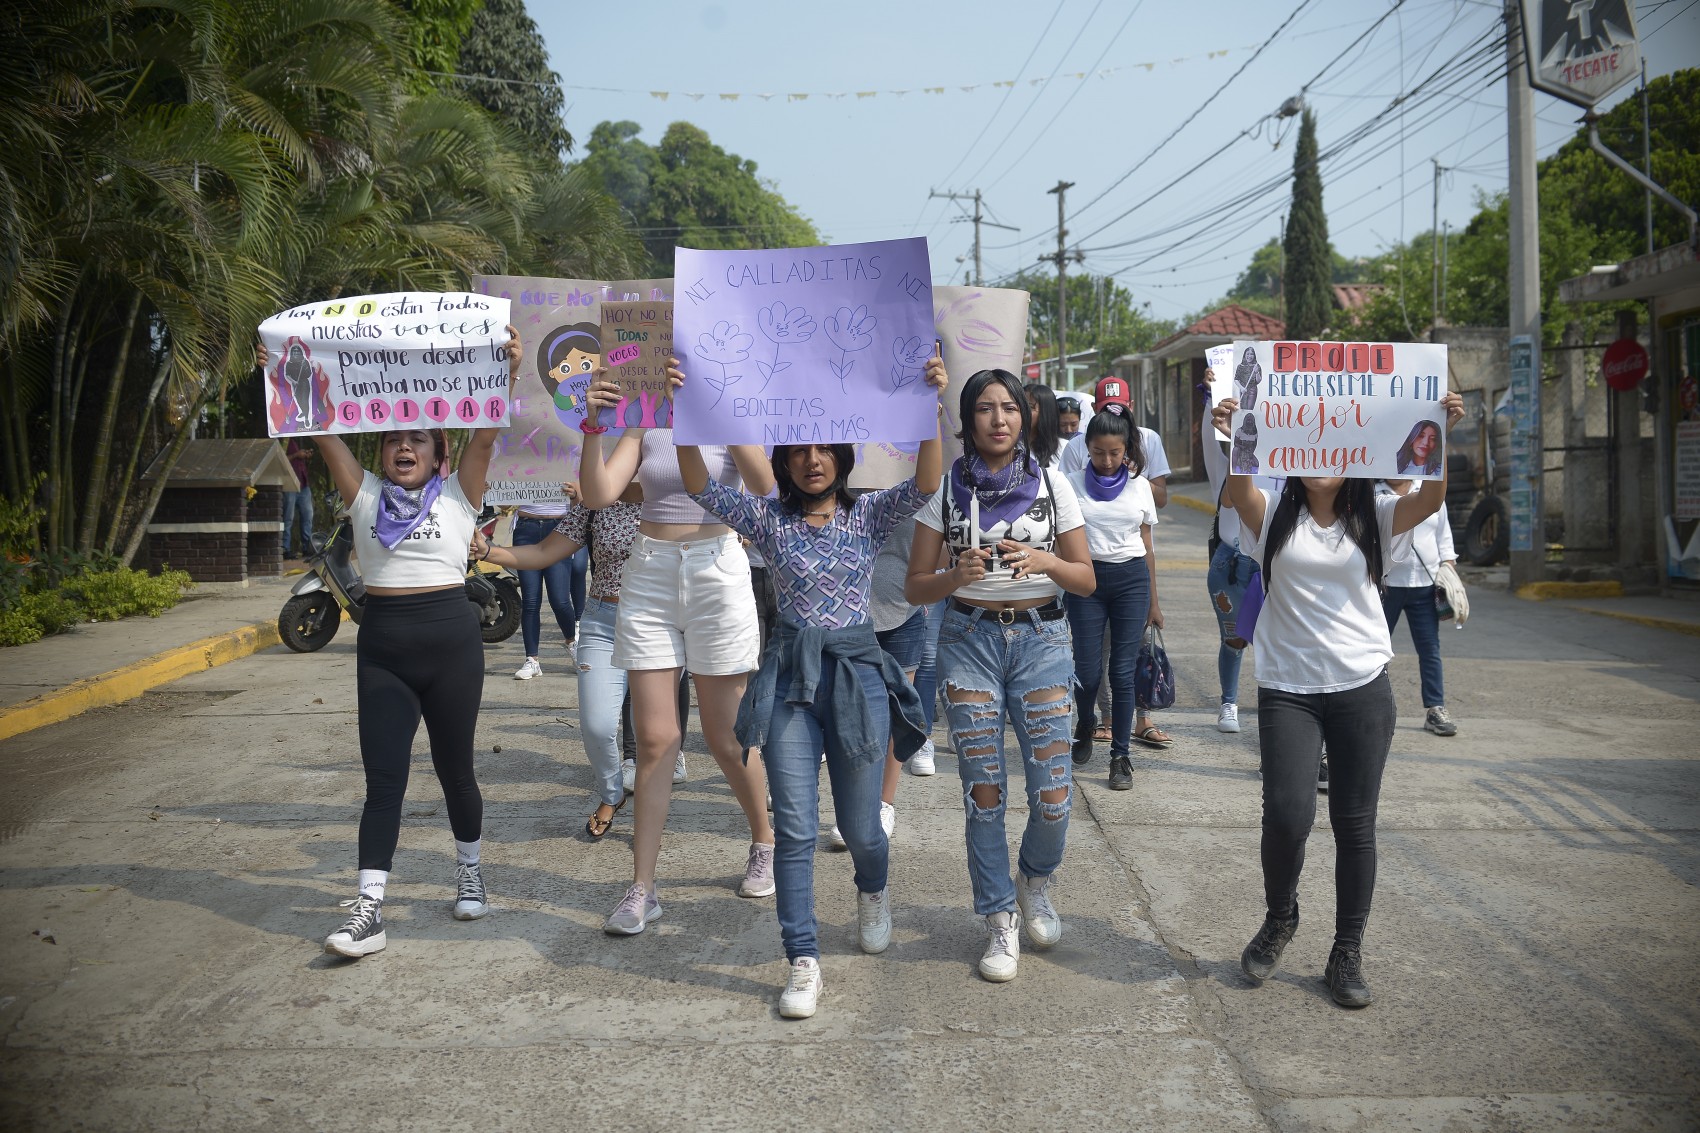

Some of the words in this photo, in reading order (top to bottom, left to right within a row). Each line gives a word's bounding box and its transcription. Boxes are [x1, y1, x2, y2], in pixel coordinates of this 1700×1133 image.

[1562, 53, 1619, 84] TECATE
[684, 278, 716, 306] NI
[726, 255, 883, 288] CALLADITAS
[897, 271, 929, 302] NI
[380, 296, 423, 318] estan
[430, 296, 490, 313] todas
[520, 288, 560, 306] QUE
[566, 287, 594, 307] NO
[605, 308, 633, 324] HOY
[640, 309, 656, 321] NO
[311, 318, 383, 341] nuestras
[390, 317, 498, 338] voces
[614, 328, 649, 343] TODAS
[338, 348, 409, 374] porque
[422, 342, 477, 366] desde
[490, 339, 508, 362] la
[609, 345, 638, 363] VOCES
[1277, 346, 1389, 370] PROFE
[338, 371, 409, 397] tumba
[413, 378, 437, 395] no
[441, 375, 462, 393] se
[467, 368, 508, 396] puede
[620, 366, 648, 378] DESDE
[654, 366, 665, 376] LA
[570, 380, 589, 392] Hoy
[626, 380, 637, 391] SE
[641, 380, 666, 391] PUED
[1268, 373, 1379, 397] REGRESEME
[1390, 374, 1404, 398] A
[1414, 375, 1439, 401] MI
[342, 398, 501, 422] GRITAR
[732, 397, 825, 418] BONITAS
[1260, 396, 1373, 444] mejor
[763, 422, 822, 444] NUNCA
[1268, 446, 1375, 476] amiga
[516, 490, 528, 501] NO
